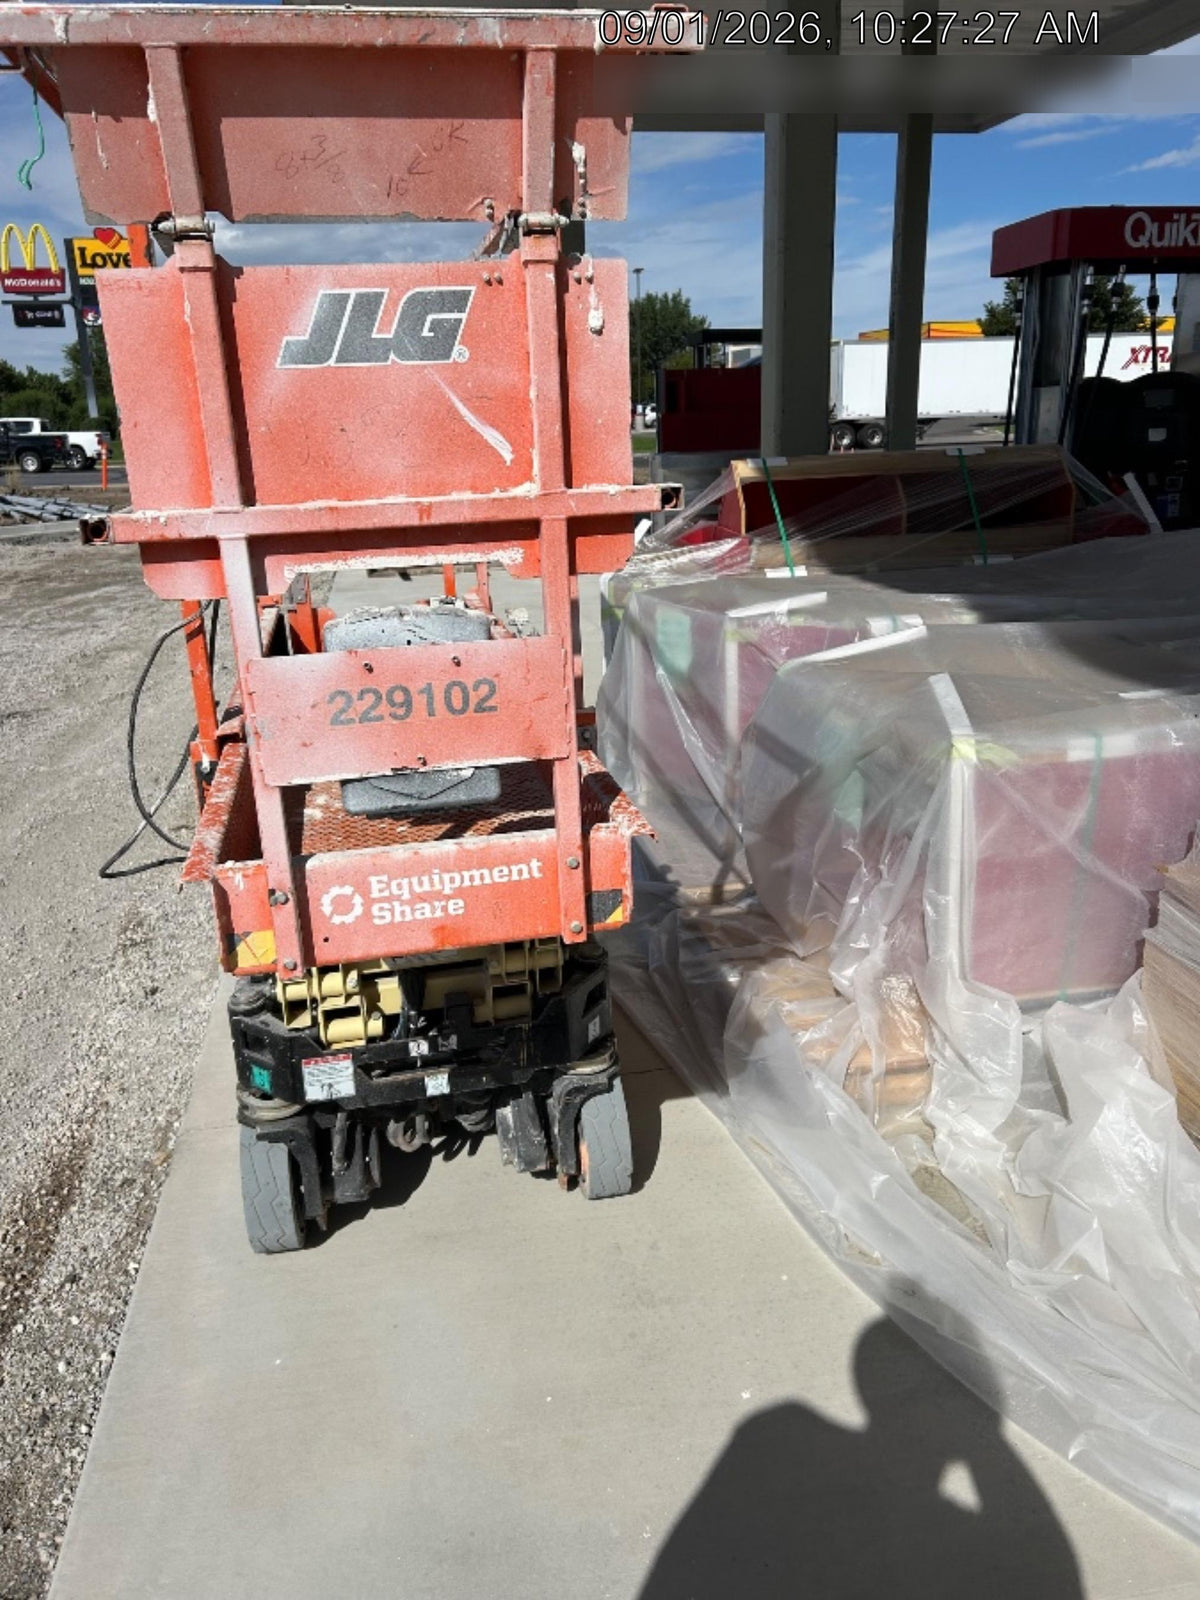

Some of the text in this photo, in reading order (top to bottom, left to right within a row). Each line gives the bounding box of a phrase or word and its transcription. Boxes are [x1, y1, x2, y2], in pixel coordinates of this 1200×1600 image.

[275, 285, 477, 369] JLG
[327, 677, 499, 726] 229102
[368, 857, 544, 901] Equipment
[371, 896, 466, 926] Share
